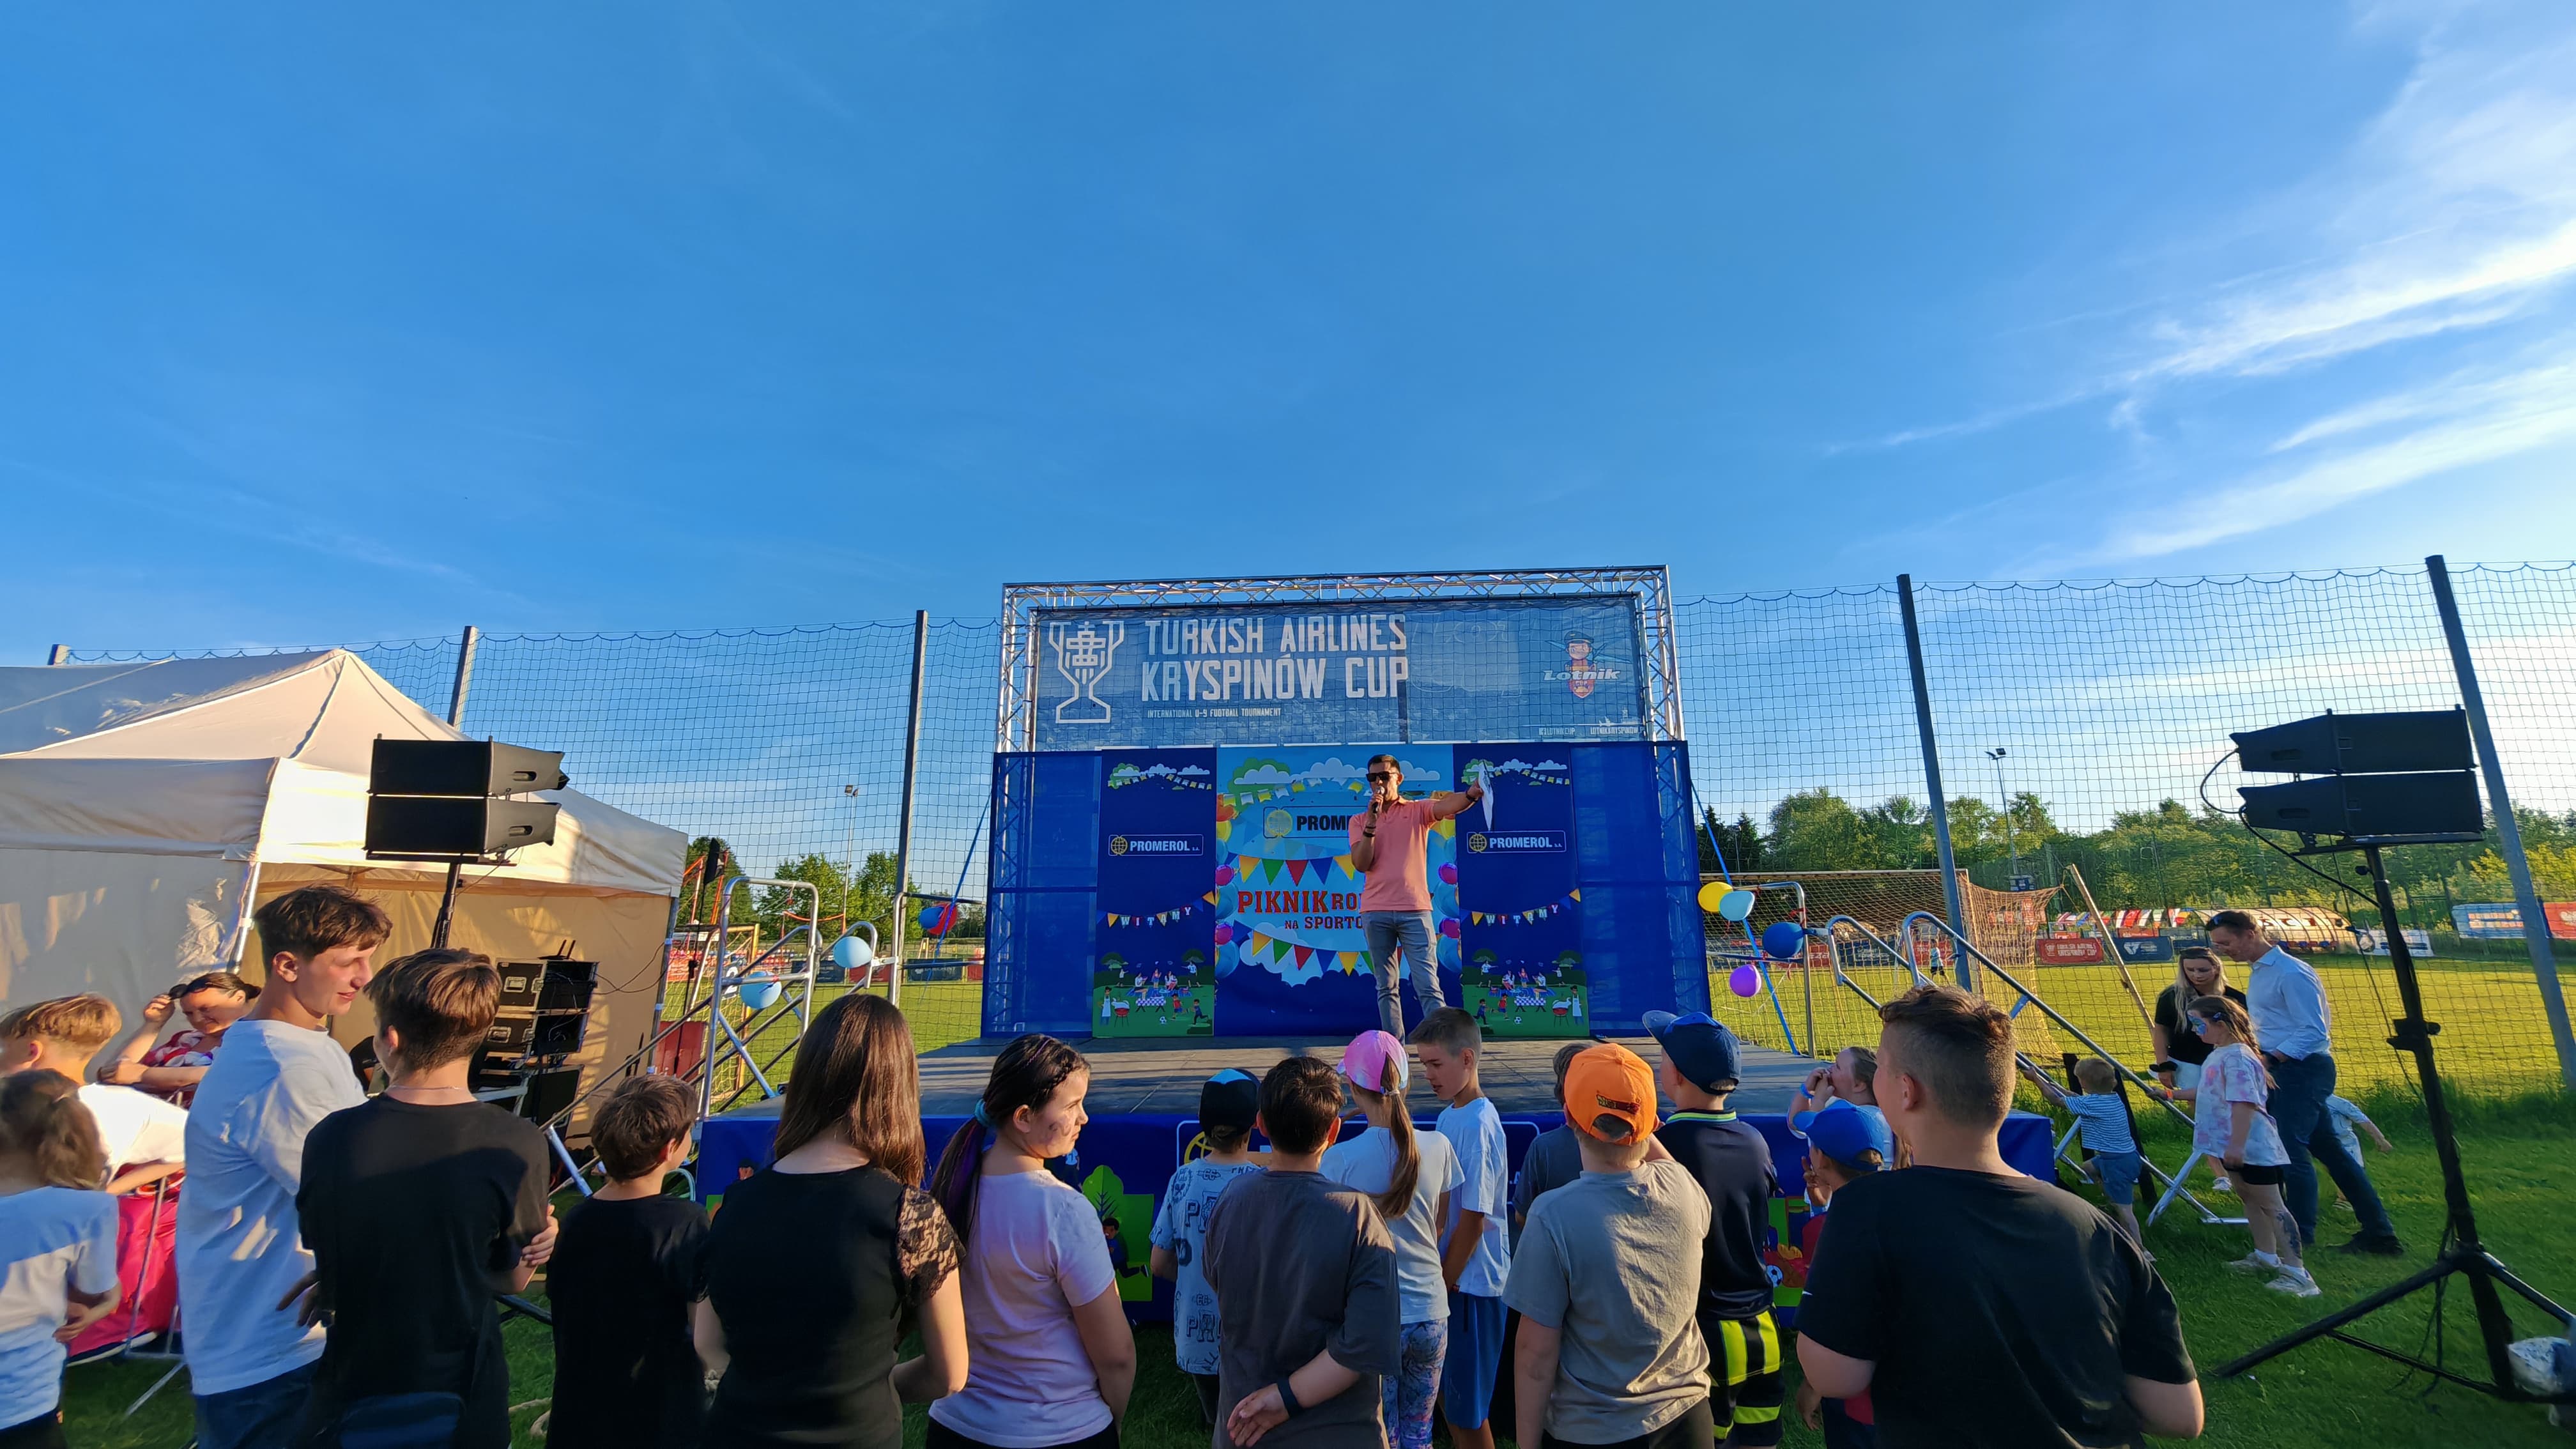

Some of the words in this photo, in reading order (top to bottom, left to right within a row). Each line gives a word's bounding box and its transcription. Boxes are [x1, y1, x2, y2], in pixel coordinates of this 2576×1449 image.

[1145, 617, 1264, 656] TURKISH
[1280, 613, 1407, 653] AIRLINES
[1142, 654, 1327, 702] KRYSPINÓW
[1346, 656, 1409, 698] CUP
[1542, 668, 1621, 681] Lotnik
[1147, 709, 1193, 718] INTERNATIONAL
[1195, 709, 1208, 717] U-9
[1209, 708, 1239, 717] FOOTBALL
[1241, 707, 1282, 717] TOURNAMENT
[1130, 840, 1190, 852] PROMEROL
[1489, 836, 1552, 848] PROMEROL
[1238, 891, 1329, 914] PIKNIK
[1331, 893, 1362, 910] RO
[1121, 907, 1192, 926] WITAMY
[1486, 904, 1558, 925] WITAMY
[1284, 919, 1299, 930] NA
[1304, 916, 1363, 930] SPORTO
